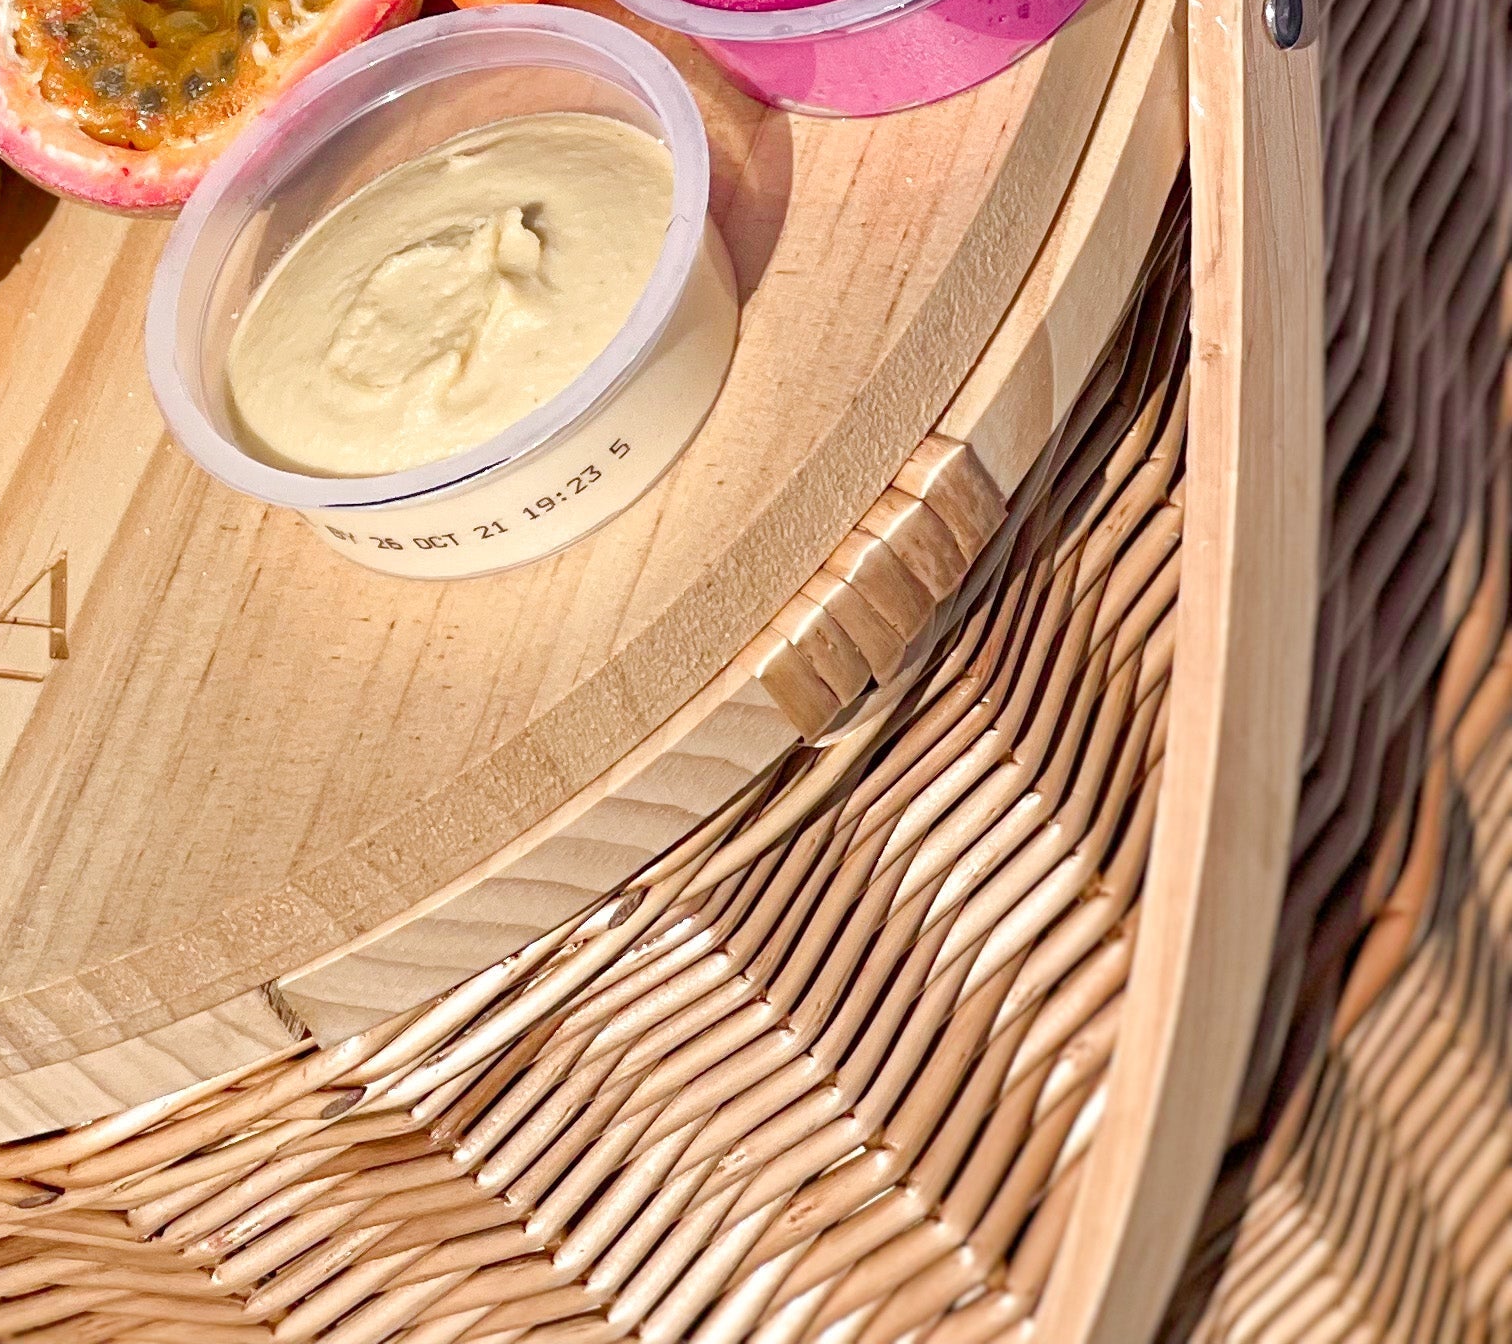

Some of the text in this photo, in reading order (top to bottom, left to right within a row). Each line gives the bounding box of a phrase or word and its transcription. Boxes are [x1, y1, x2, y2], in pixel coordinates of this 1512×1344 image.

[369, 534, 404, 551] 26
[412, 531, 464, 551] OCT
[472, 519, 510, 540] 21
[521, 464, 604, 521] 19:23
[608, 436, 633, 461] 5
